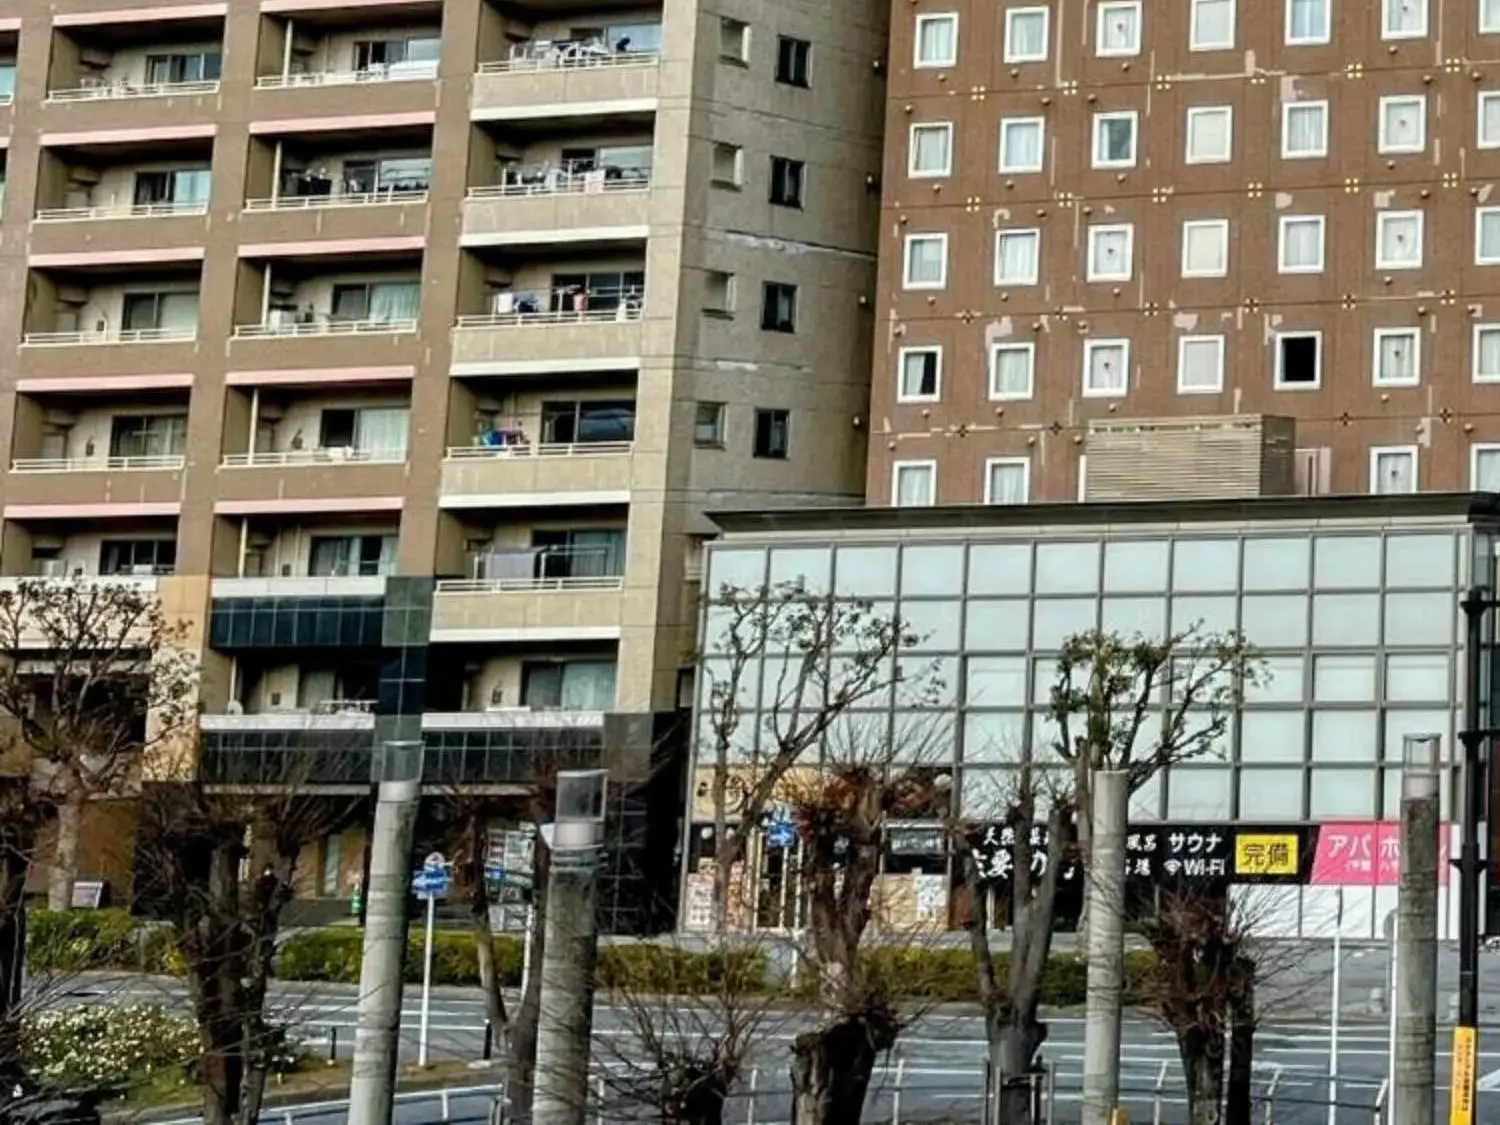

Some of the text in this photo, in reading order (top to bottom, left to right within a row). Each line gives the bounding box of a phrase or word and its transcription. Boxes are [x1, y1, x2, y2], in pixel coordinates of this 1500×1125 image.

[1168, 832, 1223, 853] サウナ
[1243, 842, 1289, 868] 完備
